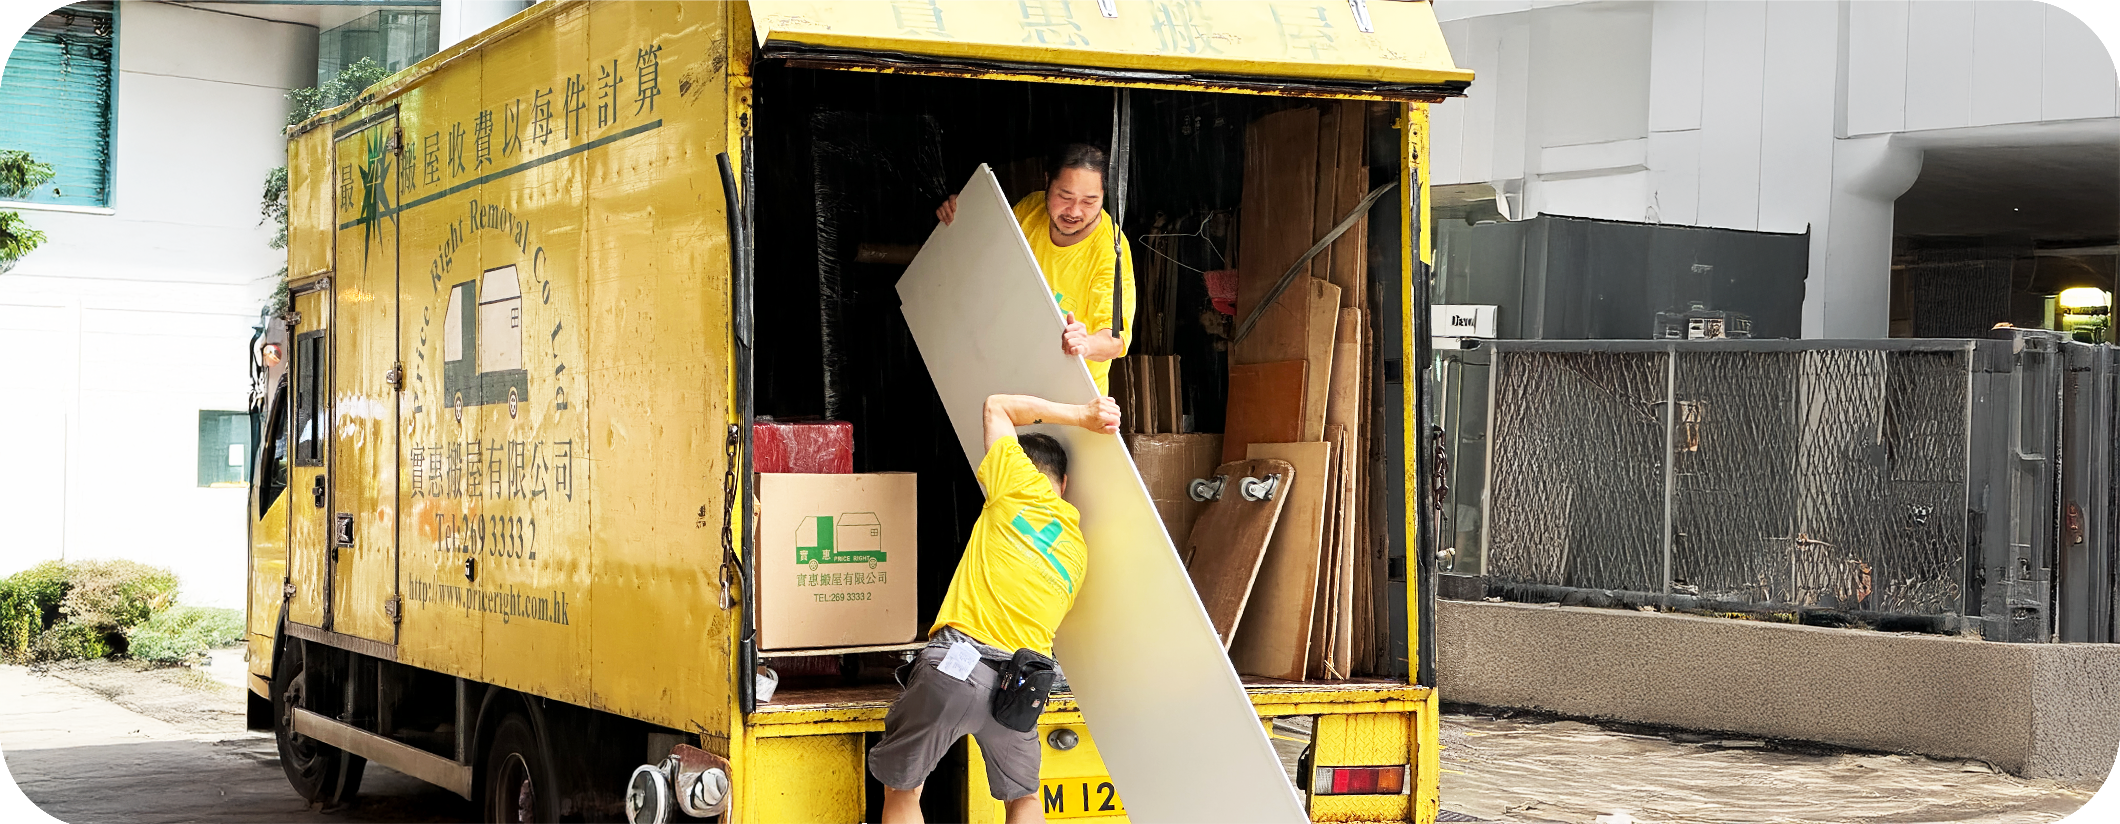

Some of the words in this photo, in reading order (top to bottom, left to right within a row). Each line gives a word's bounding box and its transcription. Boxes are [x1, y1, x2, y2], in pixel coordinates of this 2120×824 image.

[413, 305, 430, 413] Price
[430, 214, 464, 294] Right
[469, 199, 529, 254] Removal
[533, 246, 550, 305] Co
[410, 437, 572, 502] 實惠搬屋有限公司
[435, 512, 486, 555] Tel:269
[489, 513, 523, 559] 3333
[529, 516, 536, 560] 2
[409, 572, 569, 625] http://www.priceright.com.hk
[796, 571, 887, 587] 實惠搬屋有限公司
[813, 592, 845, 602] TEL:269
[846, 592, 865, 601] 3333
[866, 591, 872, 601] 2
[1082, 781, 1125, 812] 12
